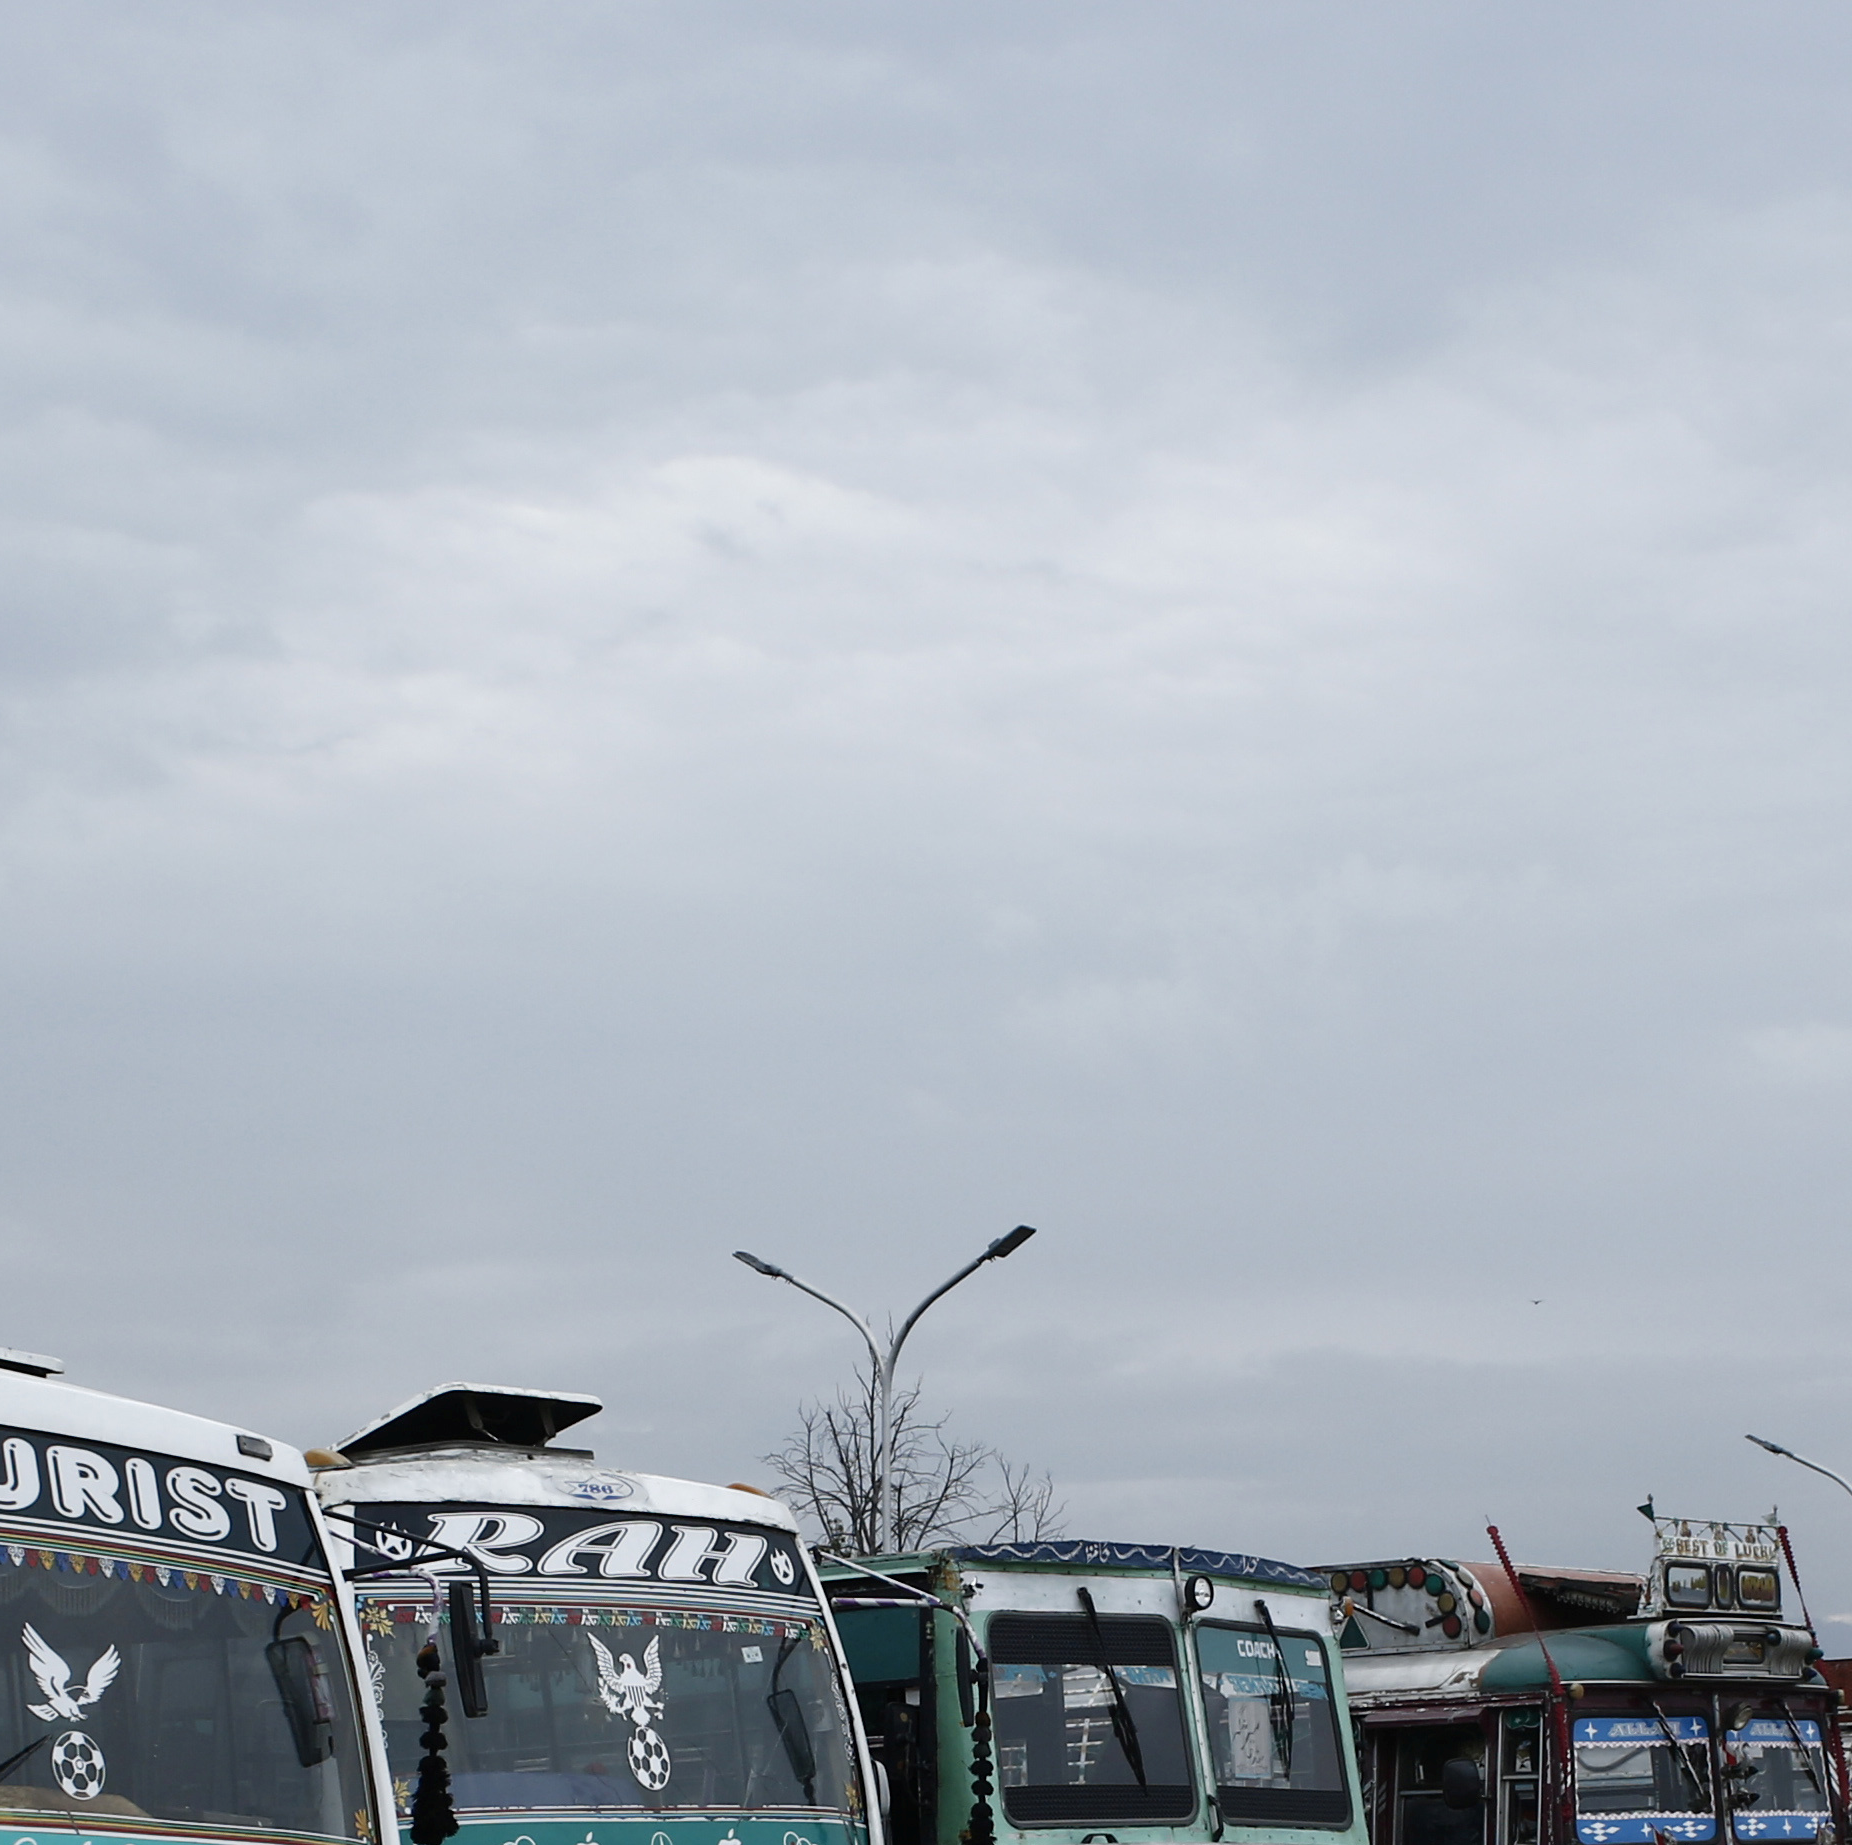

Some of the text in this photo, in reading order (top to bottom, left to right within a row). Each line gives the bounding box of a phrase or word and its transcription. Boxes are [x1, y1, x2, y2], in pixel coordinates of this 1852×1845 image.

[578, 1483, 614, 1494] 786
[1676, 1538, 1708, 1557] BEST
[1714, 1541, 1728, 1557] OF
[1237, 1640, 1275, 1660] COACH
